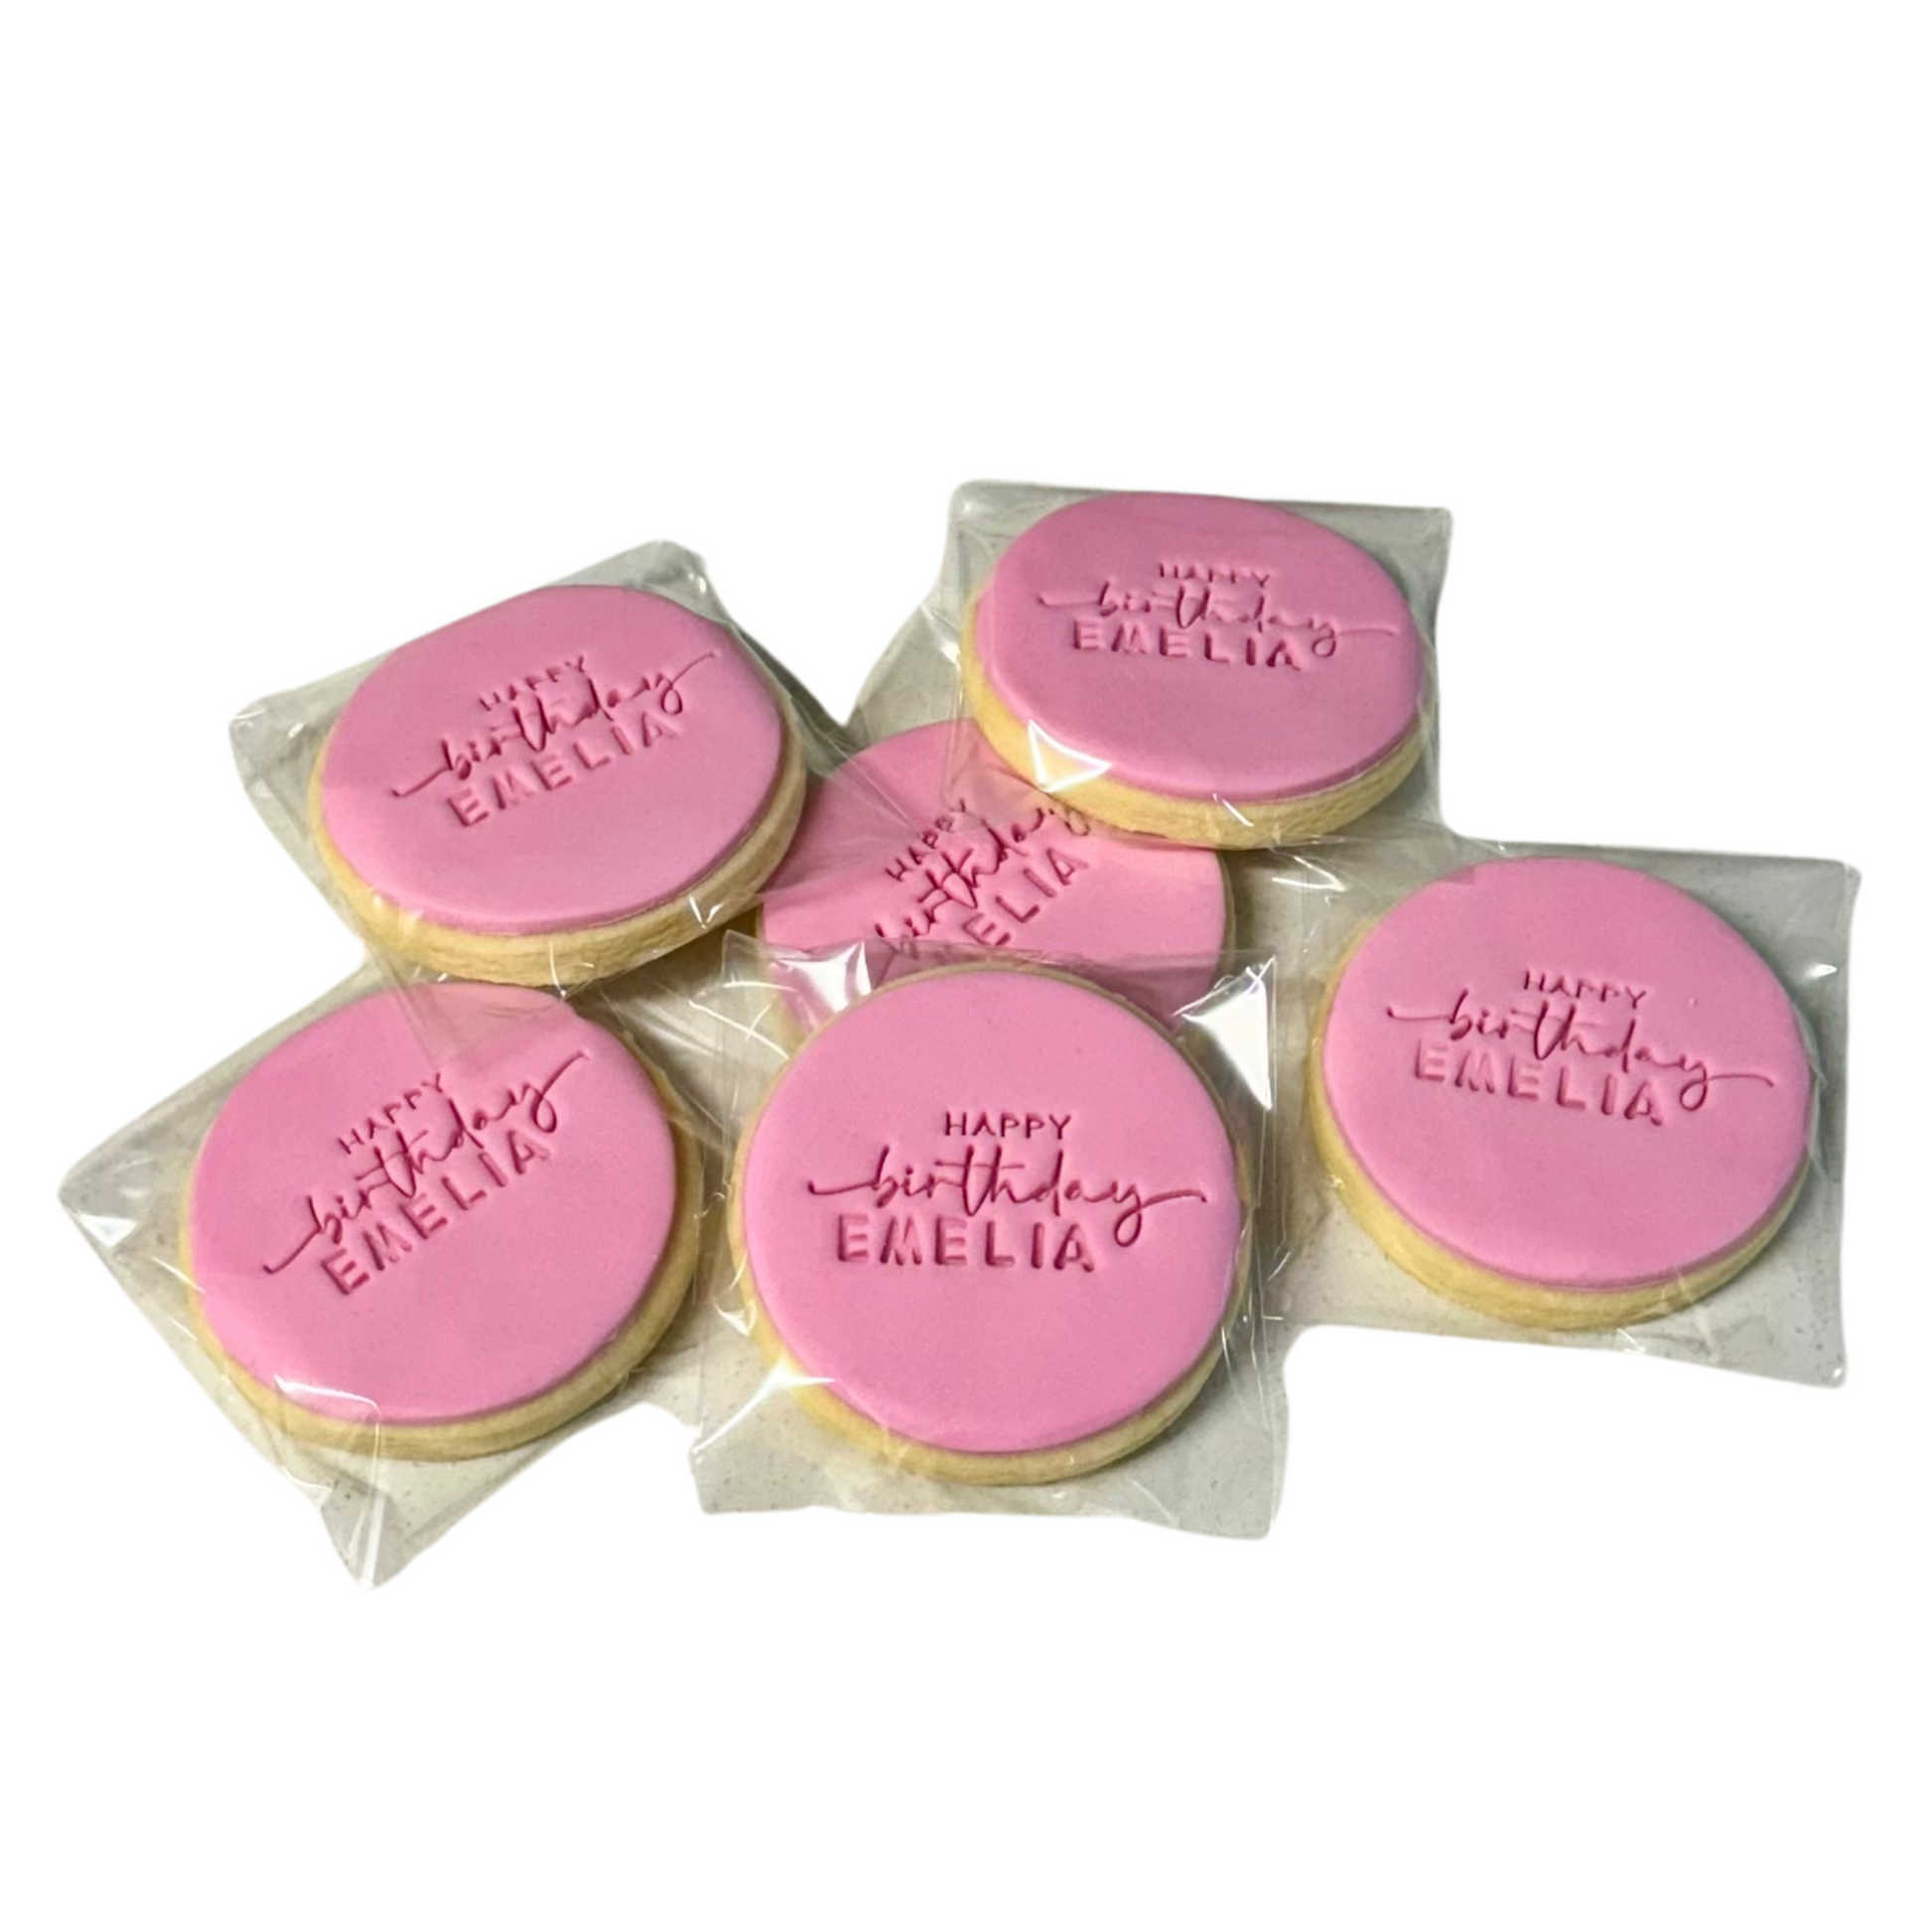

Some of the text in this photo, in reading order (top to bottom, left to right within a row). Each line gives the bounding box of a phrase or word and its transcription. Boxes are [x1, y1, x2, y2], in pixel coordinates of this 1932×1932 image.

[1158, 562, 1271, 588] HAPPY
[1072, 618, 1304, 671] EMELIA
[447, 710, 682, 827] EMELIA
[943, 847, 1090, 957] ELIA
[1524, 969, 1647, 1010] HAPPY
[1386, 989, 1775, 1112] birthday
[1415, 1038, 1663, 1127] EMELIA
[338, 1072, 443, 1155] HAPPY
[944, 1111, 1072, 1140] HAPPY
[262, 1050, 589, 1275] birthday
[807, 1145, 1208, 1247] birthday
[321, 1130, 551, 1296] EMELIA
[837, 1213, 1095, 1273] EMELIA
